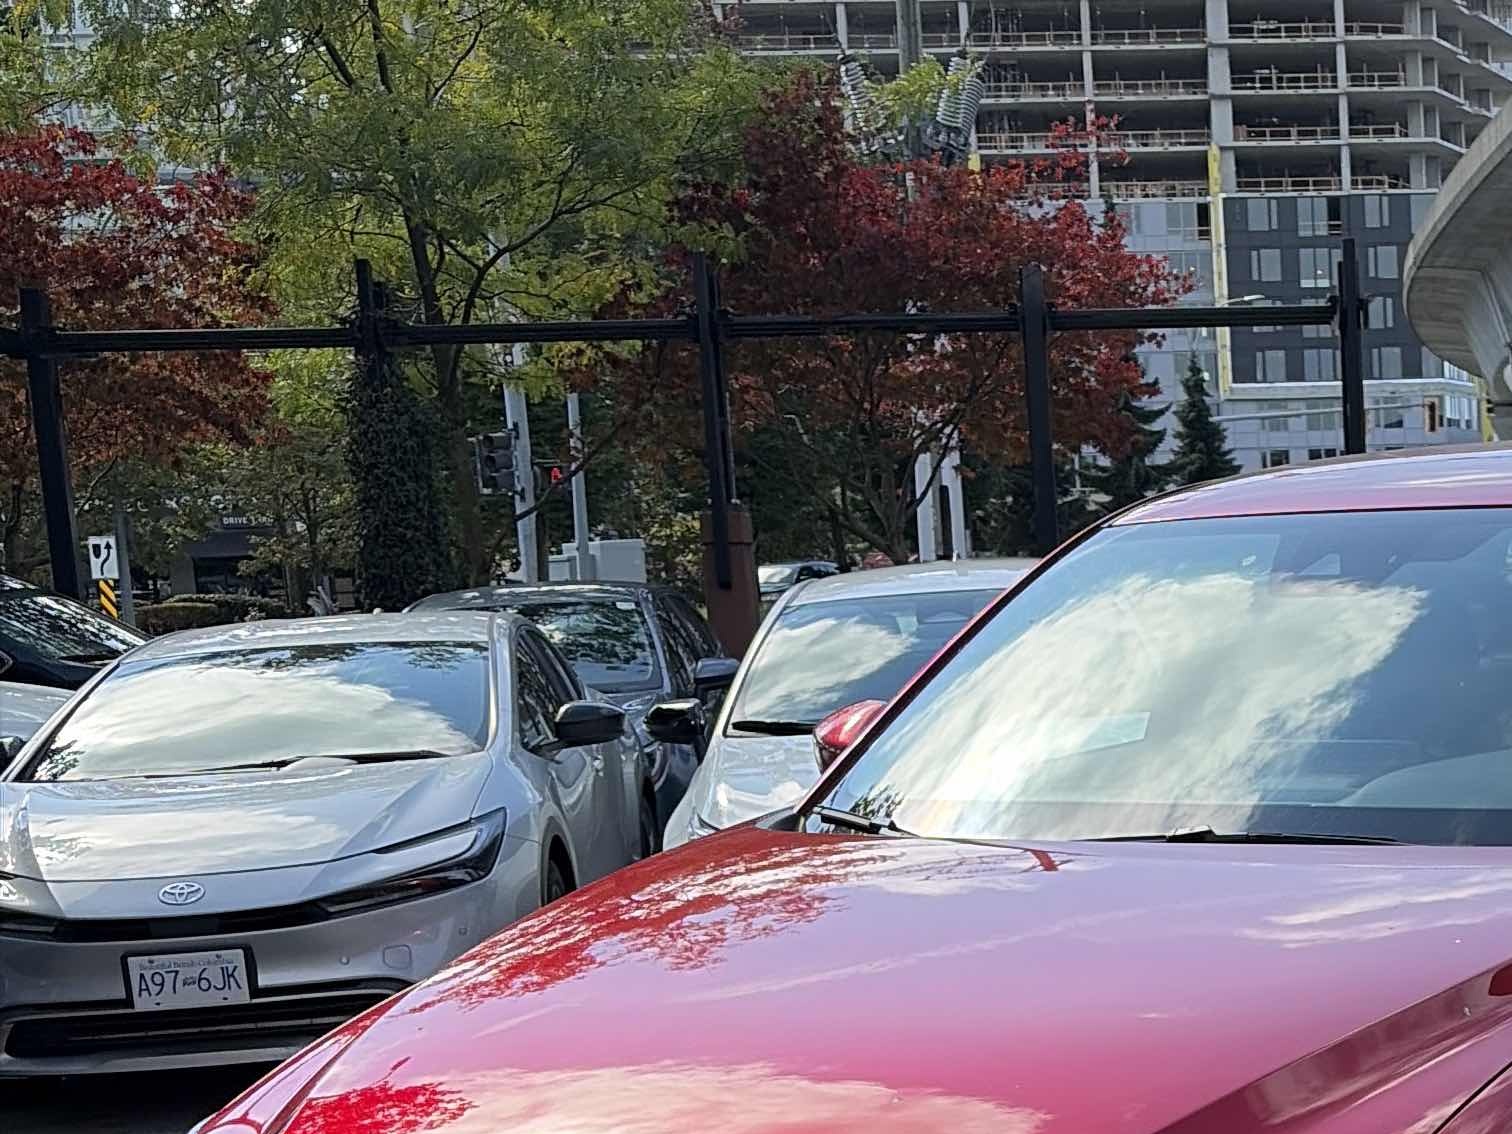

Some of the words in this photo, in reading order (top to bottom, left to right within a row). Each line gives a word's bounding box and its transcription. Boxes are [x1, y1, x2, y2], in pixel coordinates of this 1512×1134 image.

[223, 516, 248, 525] DRIVE
[138, 969, 179, 998] A97
[197, 965, 242, 992] 6JK
